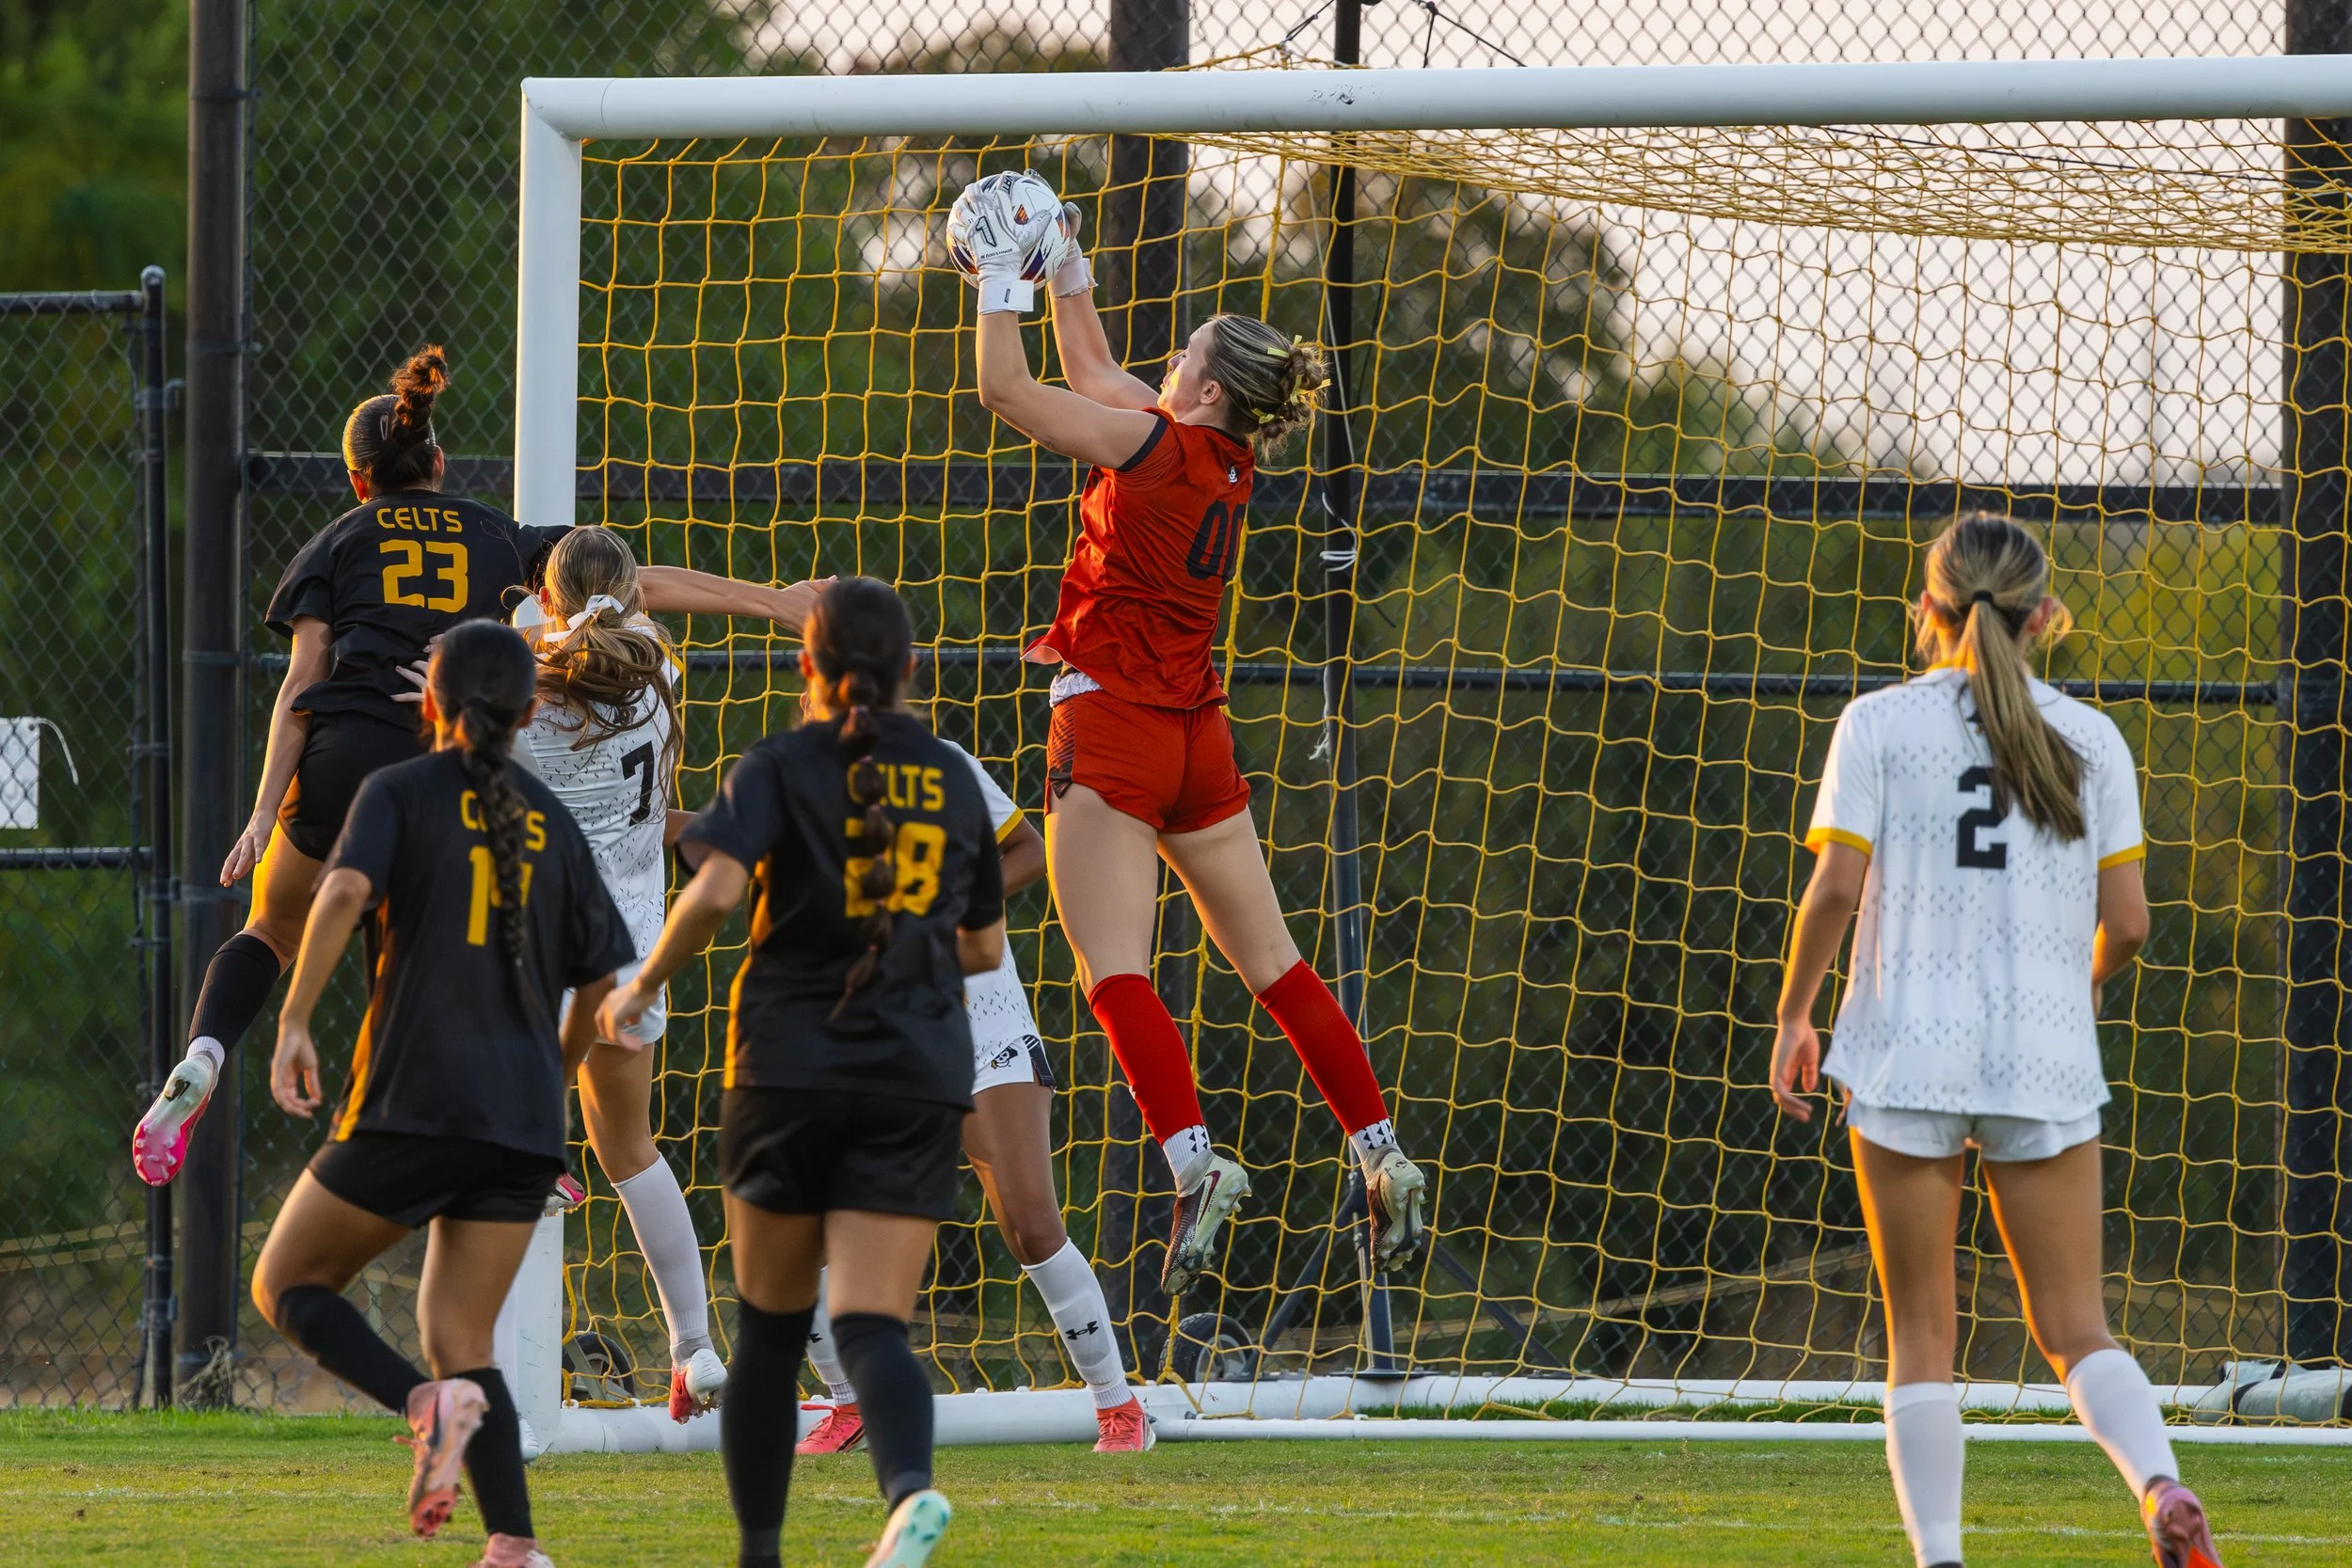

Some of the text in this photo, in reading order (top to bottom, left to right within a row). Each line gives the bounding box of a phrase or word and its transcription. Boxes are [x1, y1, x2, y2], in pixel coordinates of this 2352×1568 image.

[377, 507, 463, 533] CELTS
[379, 539, 469, 613] 23
[620, 740, 655, 828] 7
[1956, 766, 2009, 869] 2
